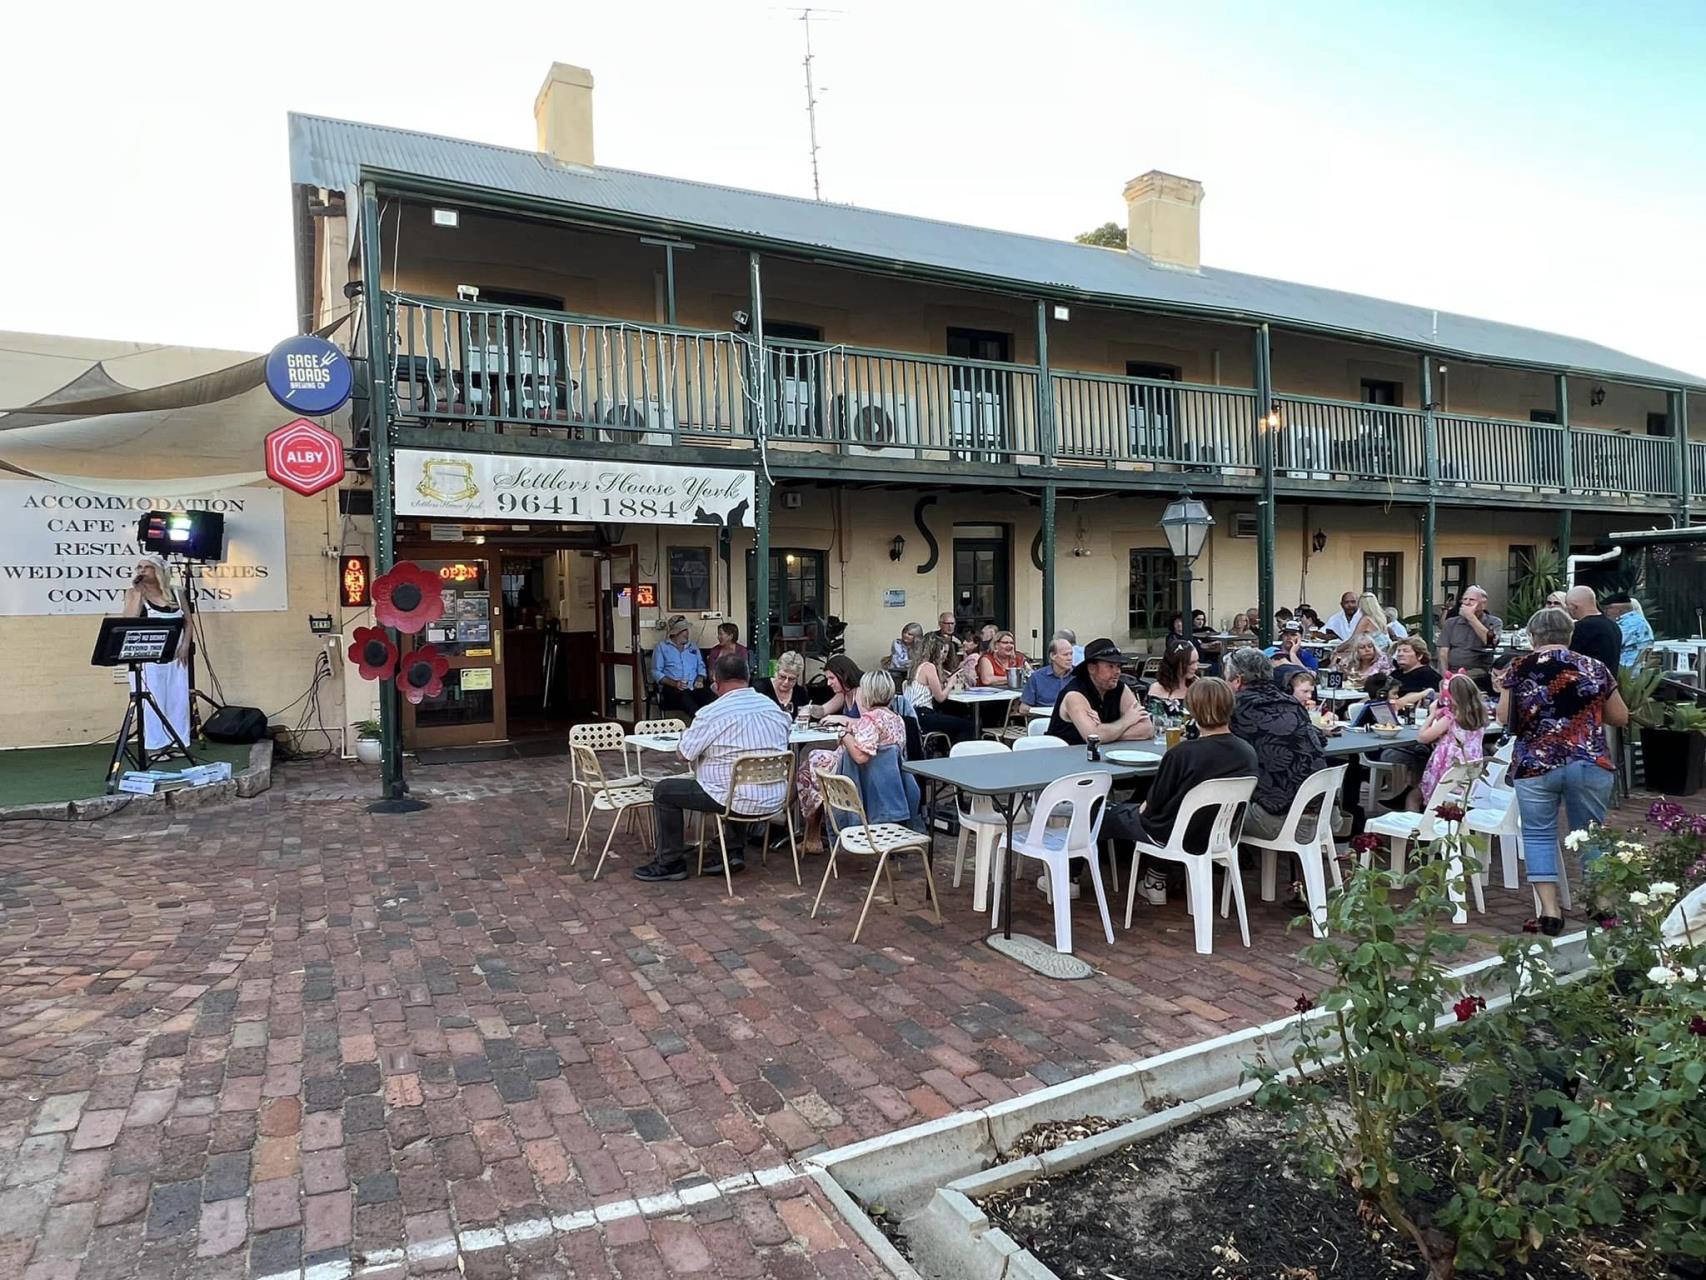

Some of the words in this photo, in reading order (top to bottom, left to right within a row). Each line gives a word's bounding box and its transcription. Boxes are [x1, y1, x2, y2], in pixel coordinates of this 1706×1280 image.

[287, 354, 319, 368] GAGE
[288, 368, 330, 382] ROADS
[287, 451, 323, 463] ALBY
[493, 466, 591, 492] Settlers
[596, 472, 676, 496] House
[680, 472, 746, 512] York
[23, 495, 245, 512] ACCOMMODATION
[497, 492, 582, 515] 9641
[602, 498, 678, 519] 1884
[48, 519, 114, 532] CAFE
[440, 565, 479, 579] OPEN
[347, 559, 363, 603] OPEN
[1329, 674, 1342, 686] 89
